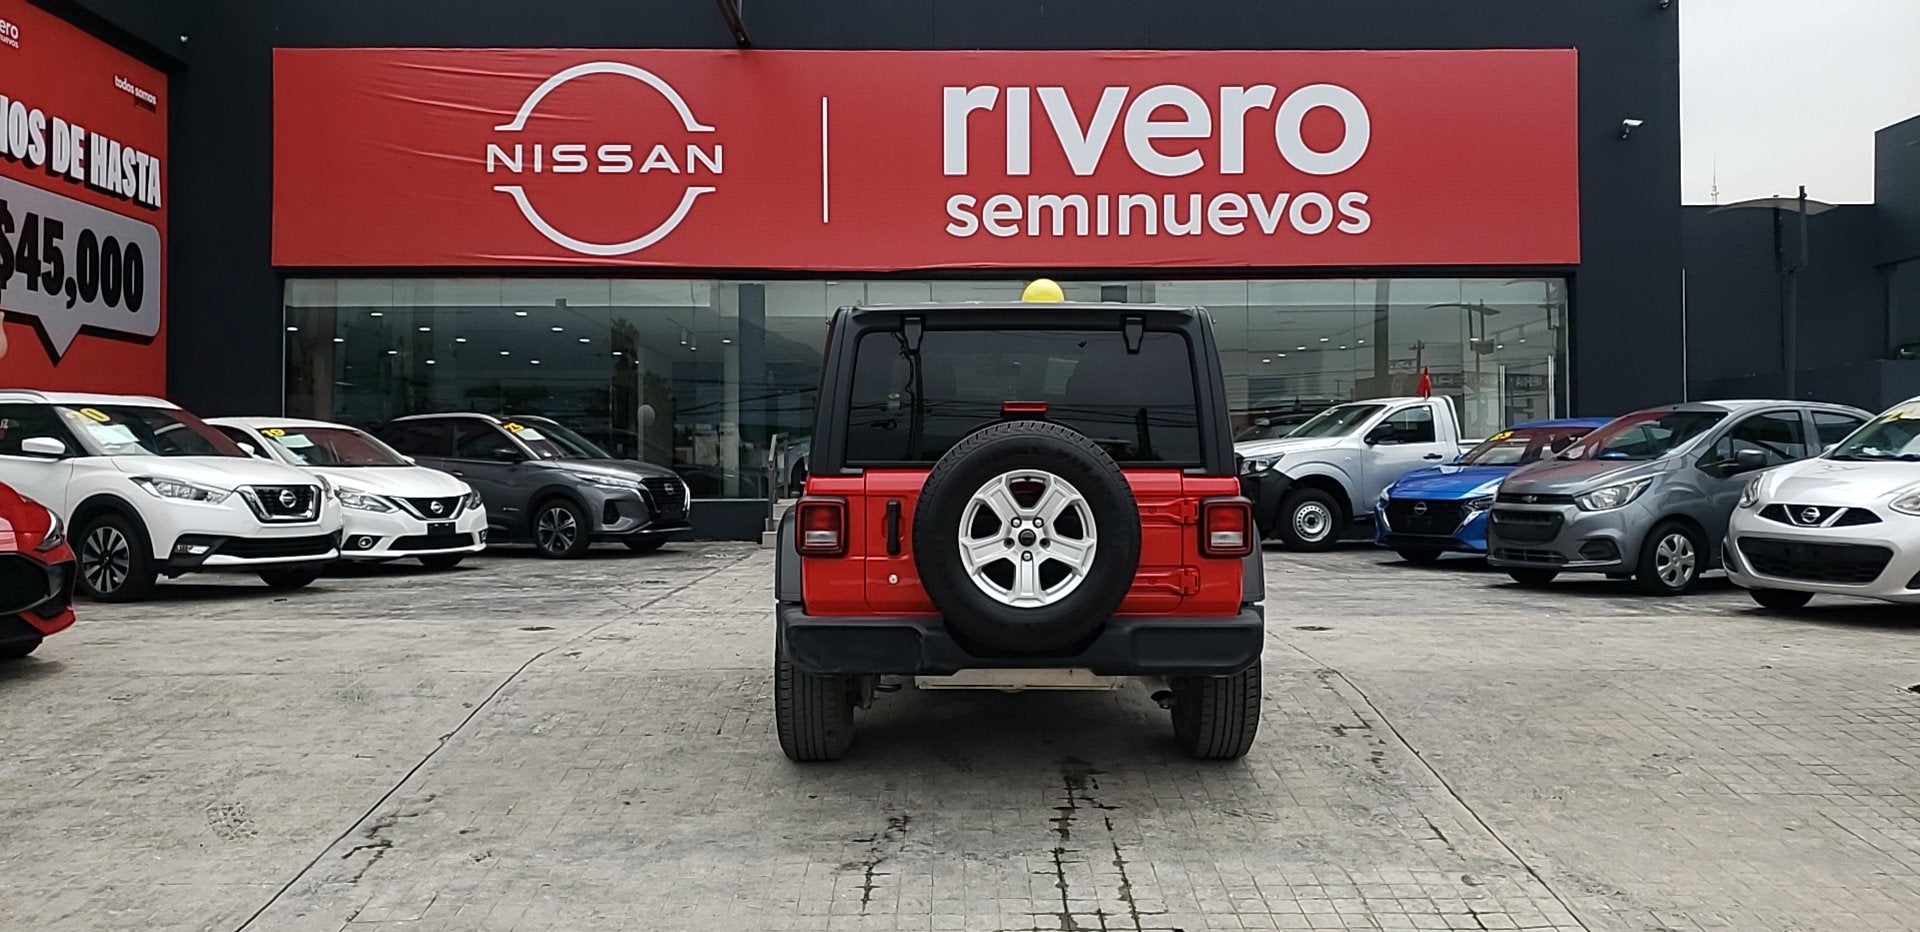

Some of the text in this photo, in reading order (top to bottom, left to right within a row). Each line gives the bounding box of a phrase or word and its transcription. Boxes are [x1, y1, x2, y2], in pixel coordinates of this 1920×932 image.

[114, 75, 157, 105] todos somos
[943, 84, 1371, 177] rivero
[52, 116, 85, 181] DE
[90, 131, 162, 208] HASTA
[486, 143, 724, 174] NISSAN
[945, 190, 1371, 237] seminuevos
